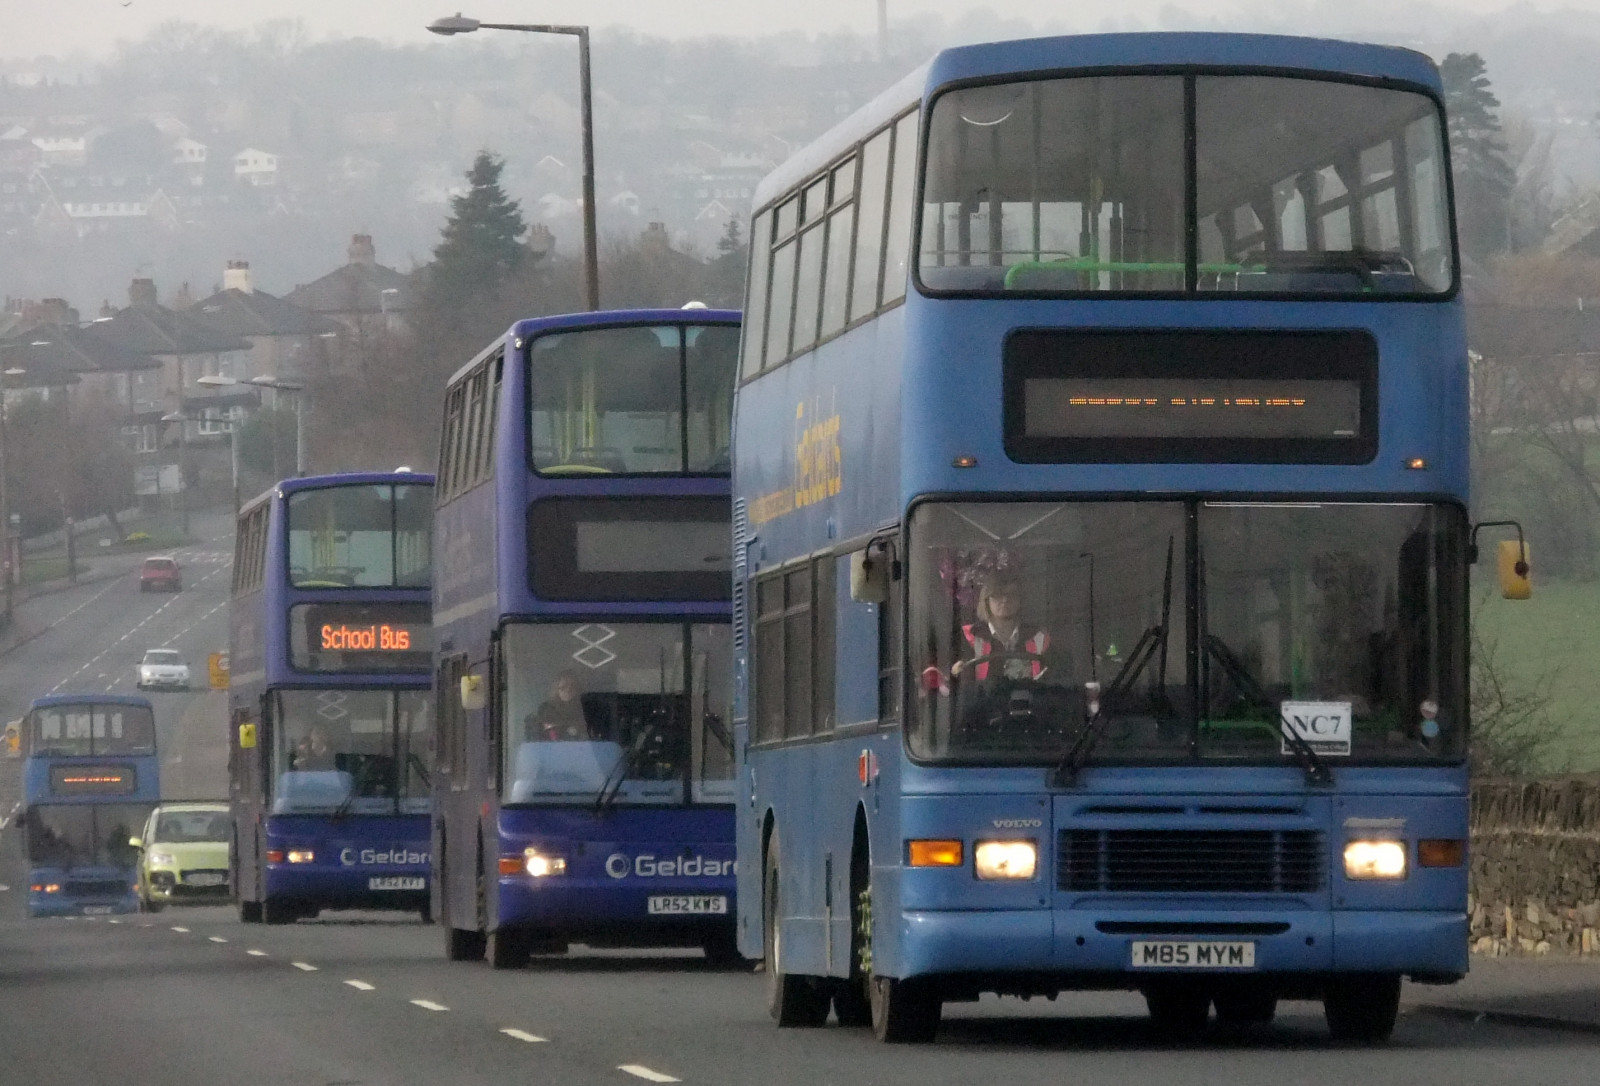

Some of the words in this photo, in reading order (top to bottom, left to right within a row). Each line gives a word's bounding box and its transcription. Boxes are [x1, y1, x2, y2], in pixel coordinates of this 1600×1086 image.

[321, 624, 376, 649] School
[380, 624, 411, 649] Bus
[1293, 714, 1341, 735] NC7
[993, 819, 1042, 828] VOLVO
[361, 849, 431, 864] Geldar
[635, 855, 738, 876] Geldar
[653, 898, 690, 912] LR52
[1143, 945, 1190, 964] M85
[1196, 945, 1243, 964] MYM
